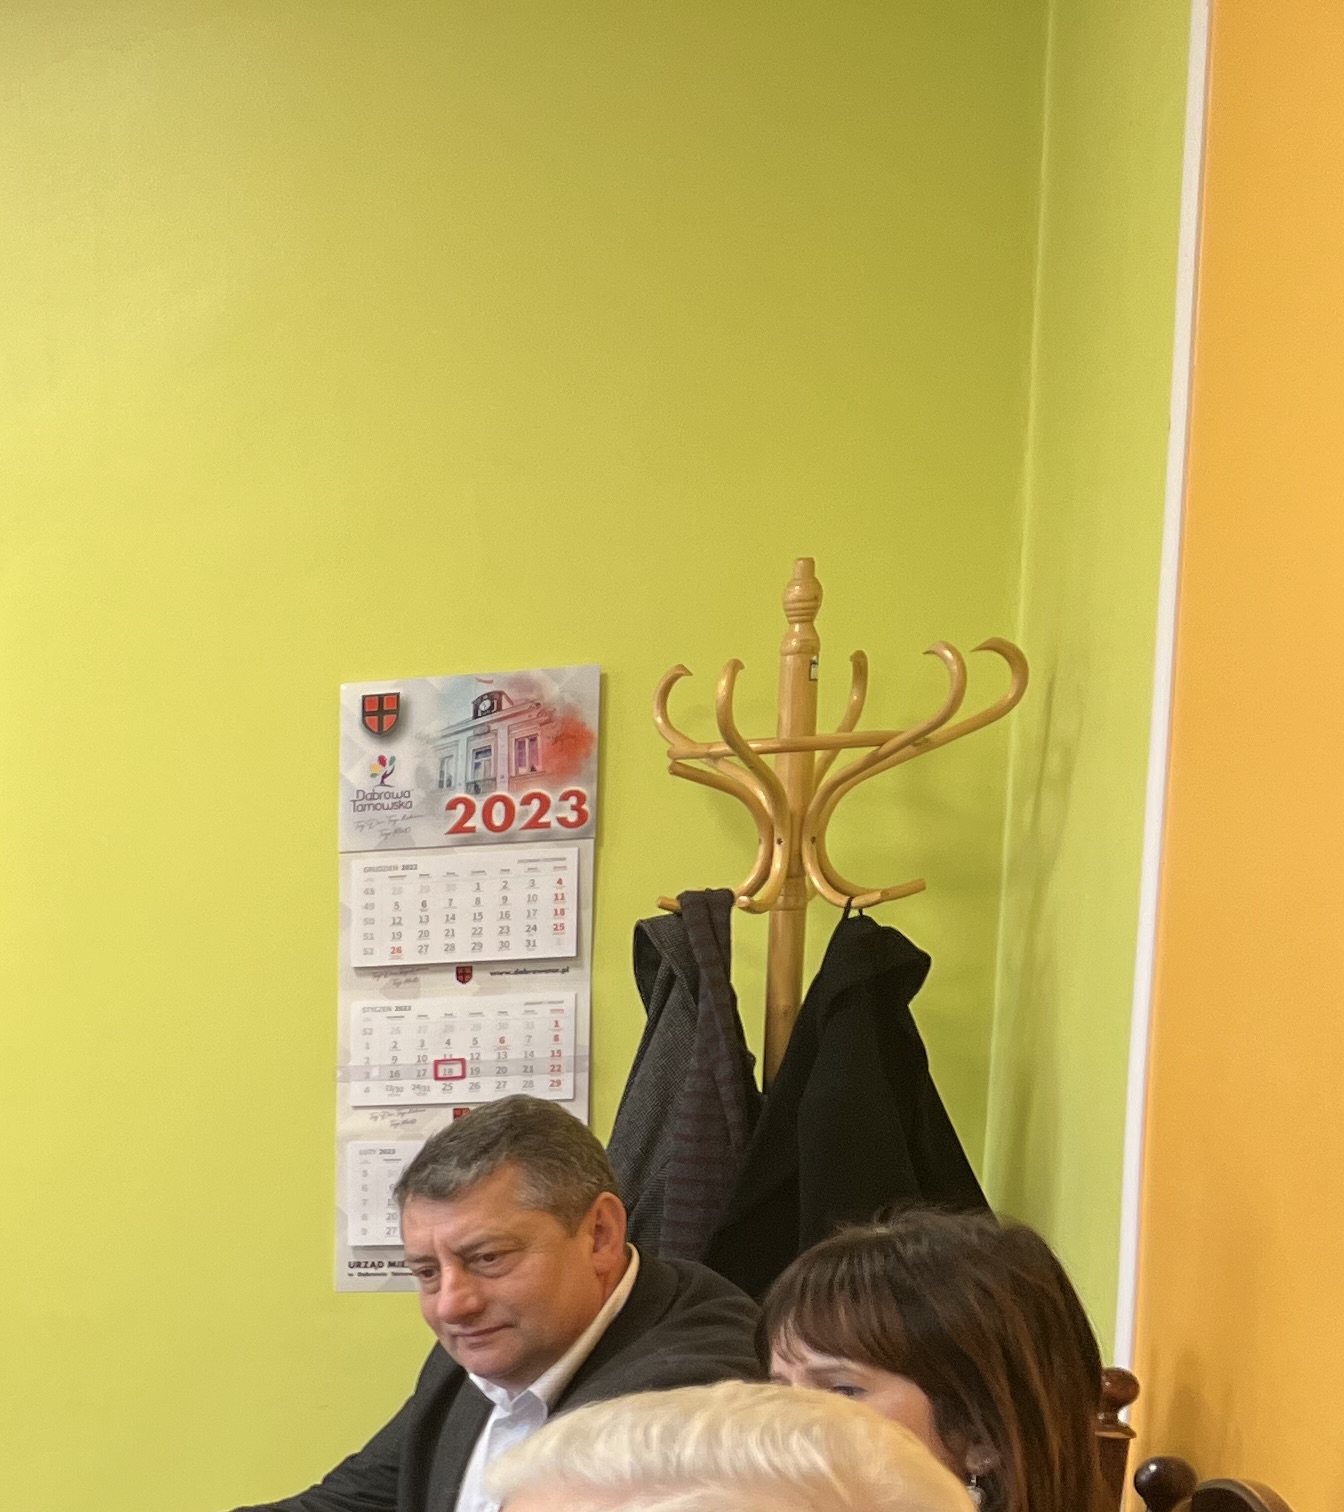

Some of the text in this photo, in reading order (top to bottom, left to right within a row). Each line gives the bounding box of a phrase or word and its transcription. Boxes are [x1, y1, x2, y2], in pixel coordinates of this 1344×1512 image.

[444, 790, 589, 835] 2023
[502, 880, 508, 889] 2
[530, 879, 535, 887] 3
[394, 901, 400, 909] 5
[421, 900, 427, 908] 6
[448, 898, 454, 907] 7
[475, 897, 481, 905] 8
[502, 896, 508, 904] 9
[527, 894, 538, 902] 10
[392, 917, 402, 925] 12
[419, 915, 429, 923] 13
[445, 914, 456, 922] 14
[473, 912, 483, 920] 15
[500, 911, 511, 919] 16
[527, 909, 538, 918] 17
[392, 931, 402, 939] 19
[418, 930, 430, 938] 20
[444, 929, 455, 937] 21
[472, 927, 483, 935] 22
[499, 926, 510, 934] 23
[525, 924, 538, 932] 24
[553, 923, 565, 931] 25
[418, 944, 429, 953] 27
[444, 943, 456, 952] 28
[471, 942, 483, 950] 29
[499, 940, 510, 949] 30
[526, 939, 537, 947] 31
[392, 1040, 398, 1049] 2
[472, 1037, 478, 1045] 5
[499, 1036, 505, 1044] 6
[417, 1055, 428, 1063] 10
[497, 1051, 508, 1060] 13
[390, 1070, 400, 1078] 16
[417, 1069, 427, 1077] 17
[443, 1068, 453, 1076] 18
[470, 1067, 480, 1075] 19
[496, 1066, 508, 1074] 20
[523, 1065, 534, 1073] 21
[550, 1064, 562, 1072] 22
[442, 1083, 453, 1091] 25
[469, 1082, 480, 1090] 26
[496, 1081, 507, 1089] 27
[522, 1080, 534, 1088] 28
[386, 1212, 398, 1220] 20
[386, 1227, 397, 1235] 27
[348, 1261, 384, 1270] URZĄD
